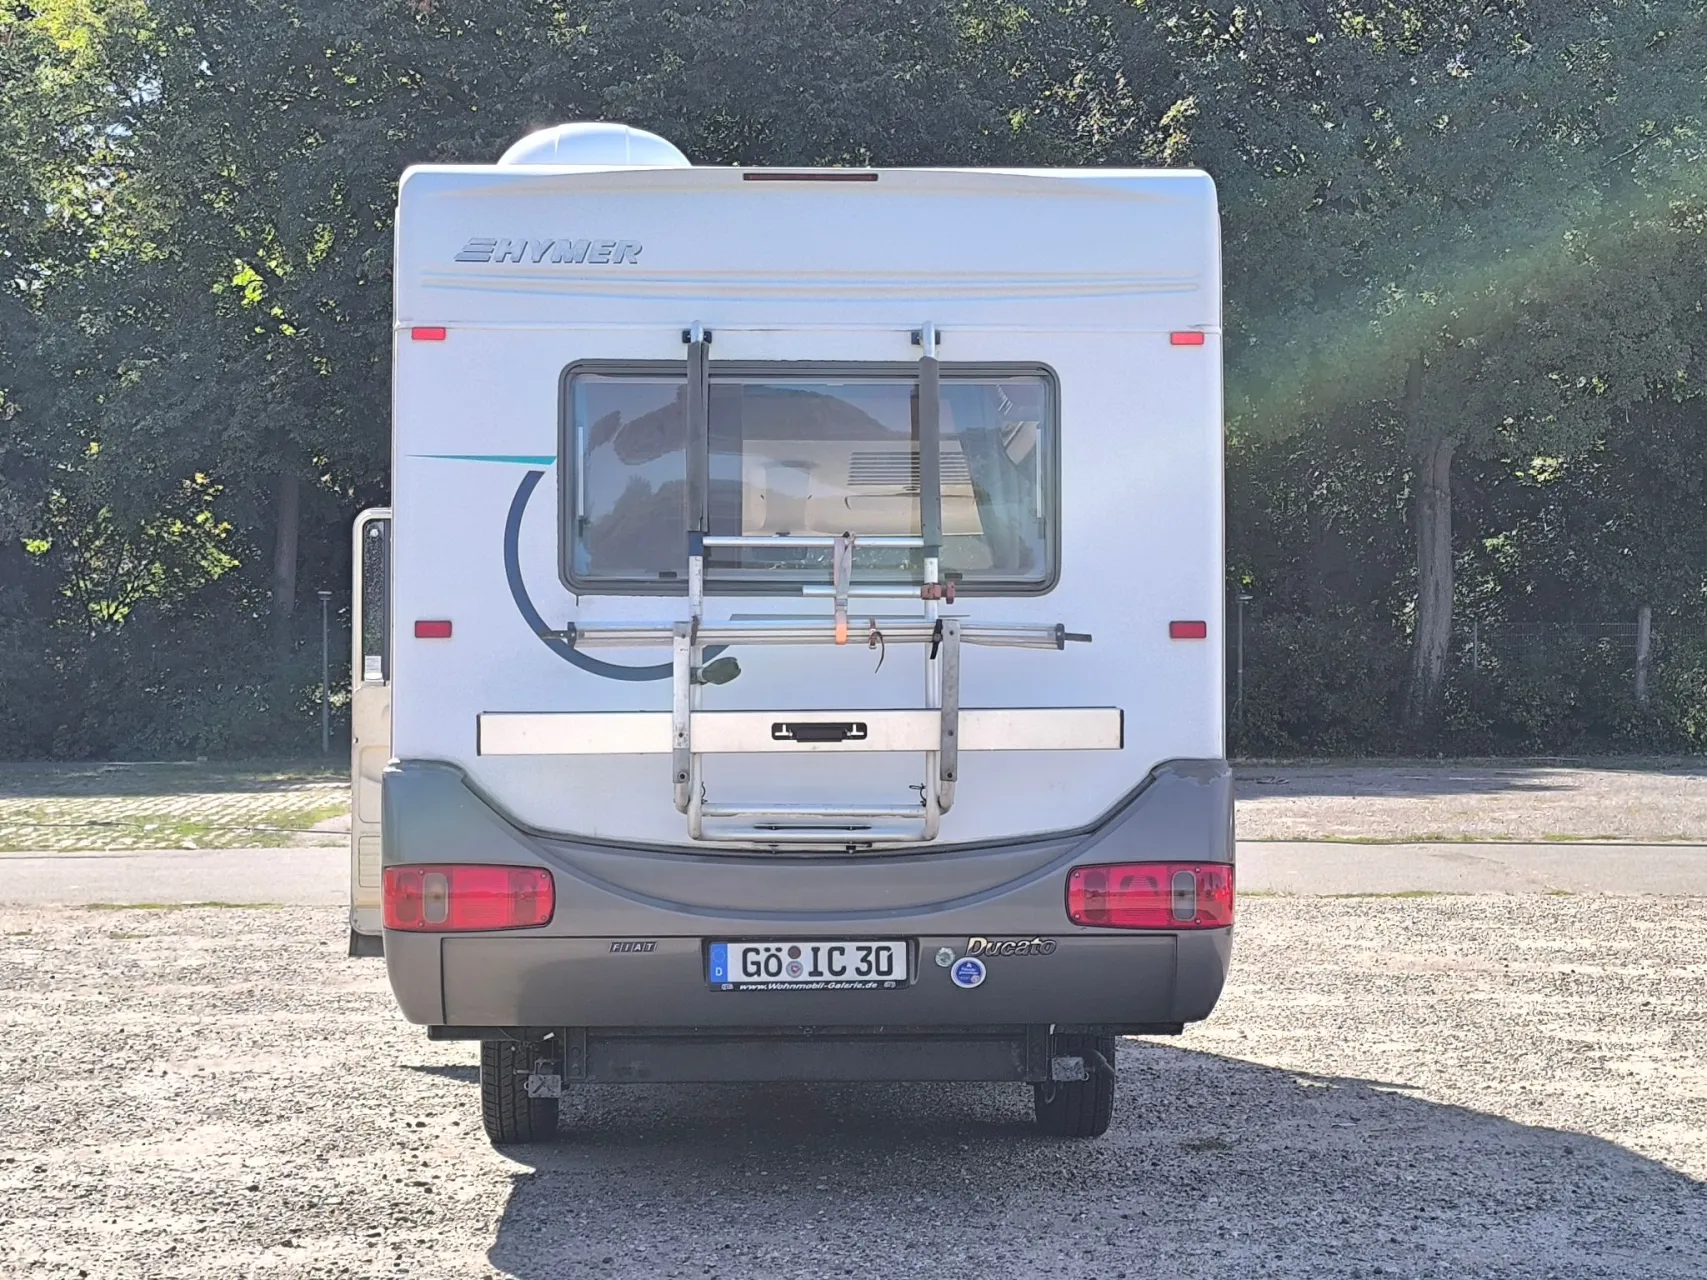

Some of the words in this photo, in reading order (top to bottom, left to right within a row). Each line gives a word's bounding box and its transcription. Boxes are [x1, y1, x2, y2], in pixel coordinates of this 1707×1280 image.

[495, 238, 643, 264] HYMER
[610, 941, 656, 953] FIAT
[966, 936, 1057, 957] Ducato
[742, 946, 783, 977] GÖ
[808, 946, 847, 977] IC
[855, 945, 893, 977] 30
[715, 967, 723, 977] D
